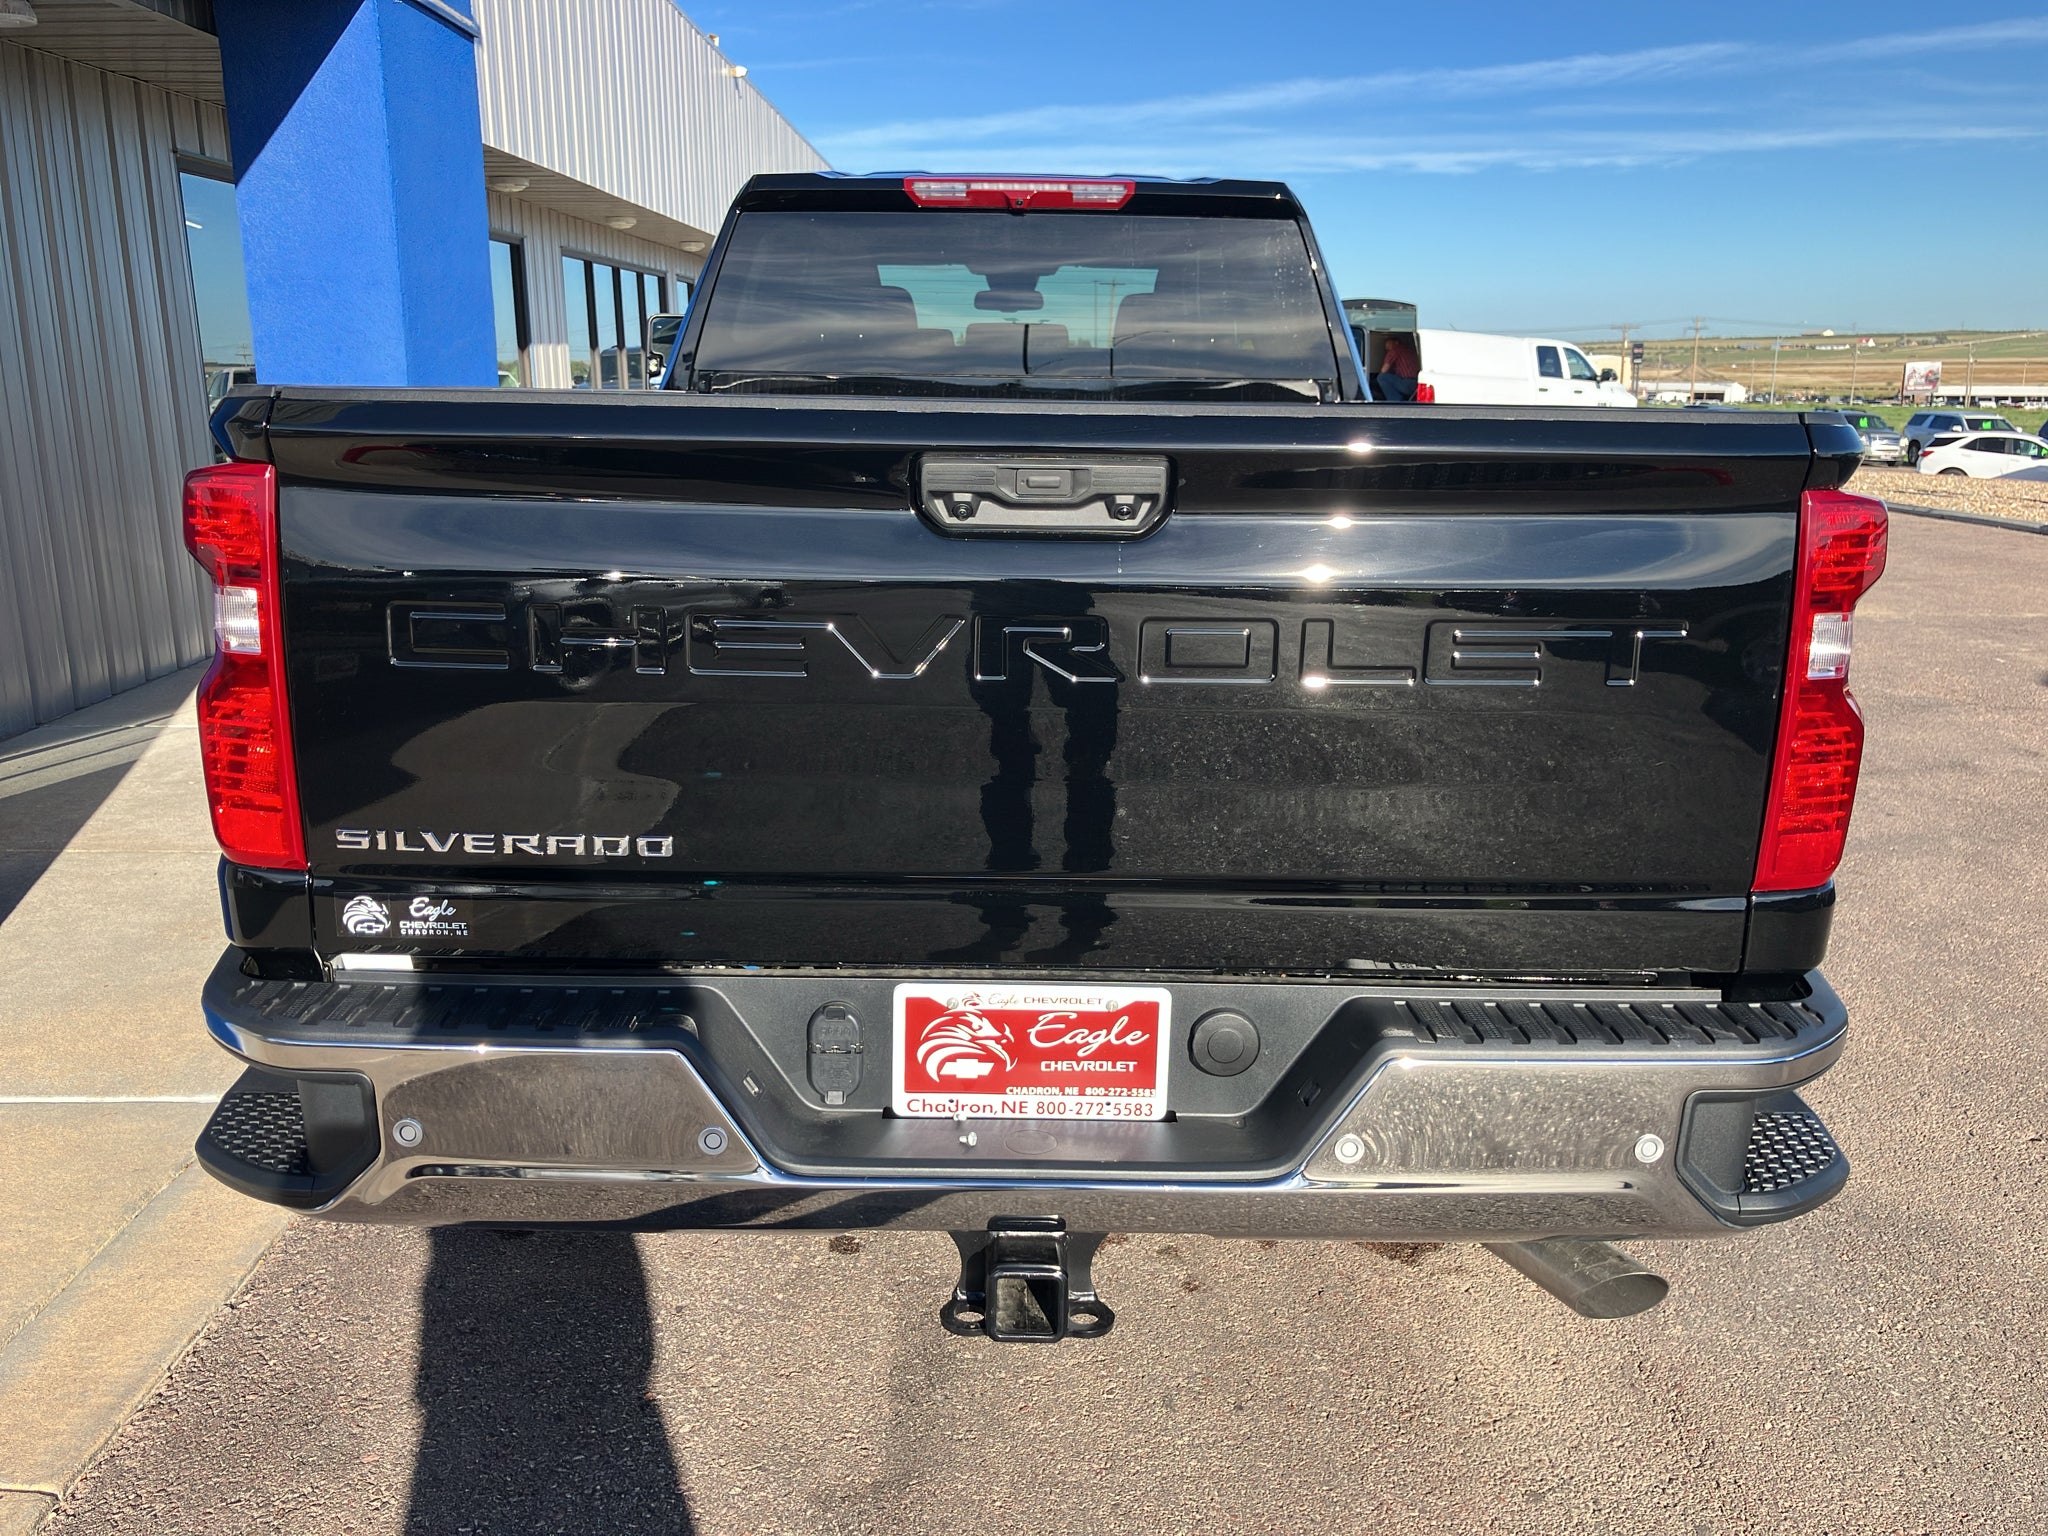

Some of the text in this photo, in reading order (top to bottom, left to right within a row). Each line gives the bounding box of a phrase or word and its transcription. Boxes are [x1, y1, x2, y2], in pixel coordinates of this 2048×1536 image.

[386, 600, 1690, 688] CHEVROLET
[336, 828, 674, 858] SILVERADO
[409, 896, 457, 921] Eagle
[400, 928, 453, 936] CHADRON,
[987, 992, 1104, 1009] Eagle CHEVROLET
[1026, 1011, 1150, 1058] Eagle
[1040, 1060, 1138, 1073] CHEVROLET
[1005, 1086, 1156, 1098] CHADRON, NE 800-272-5583
[1035, 1101, 1154, 1117] 800-272-5583
